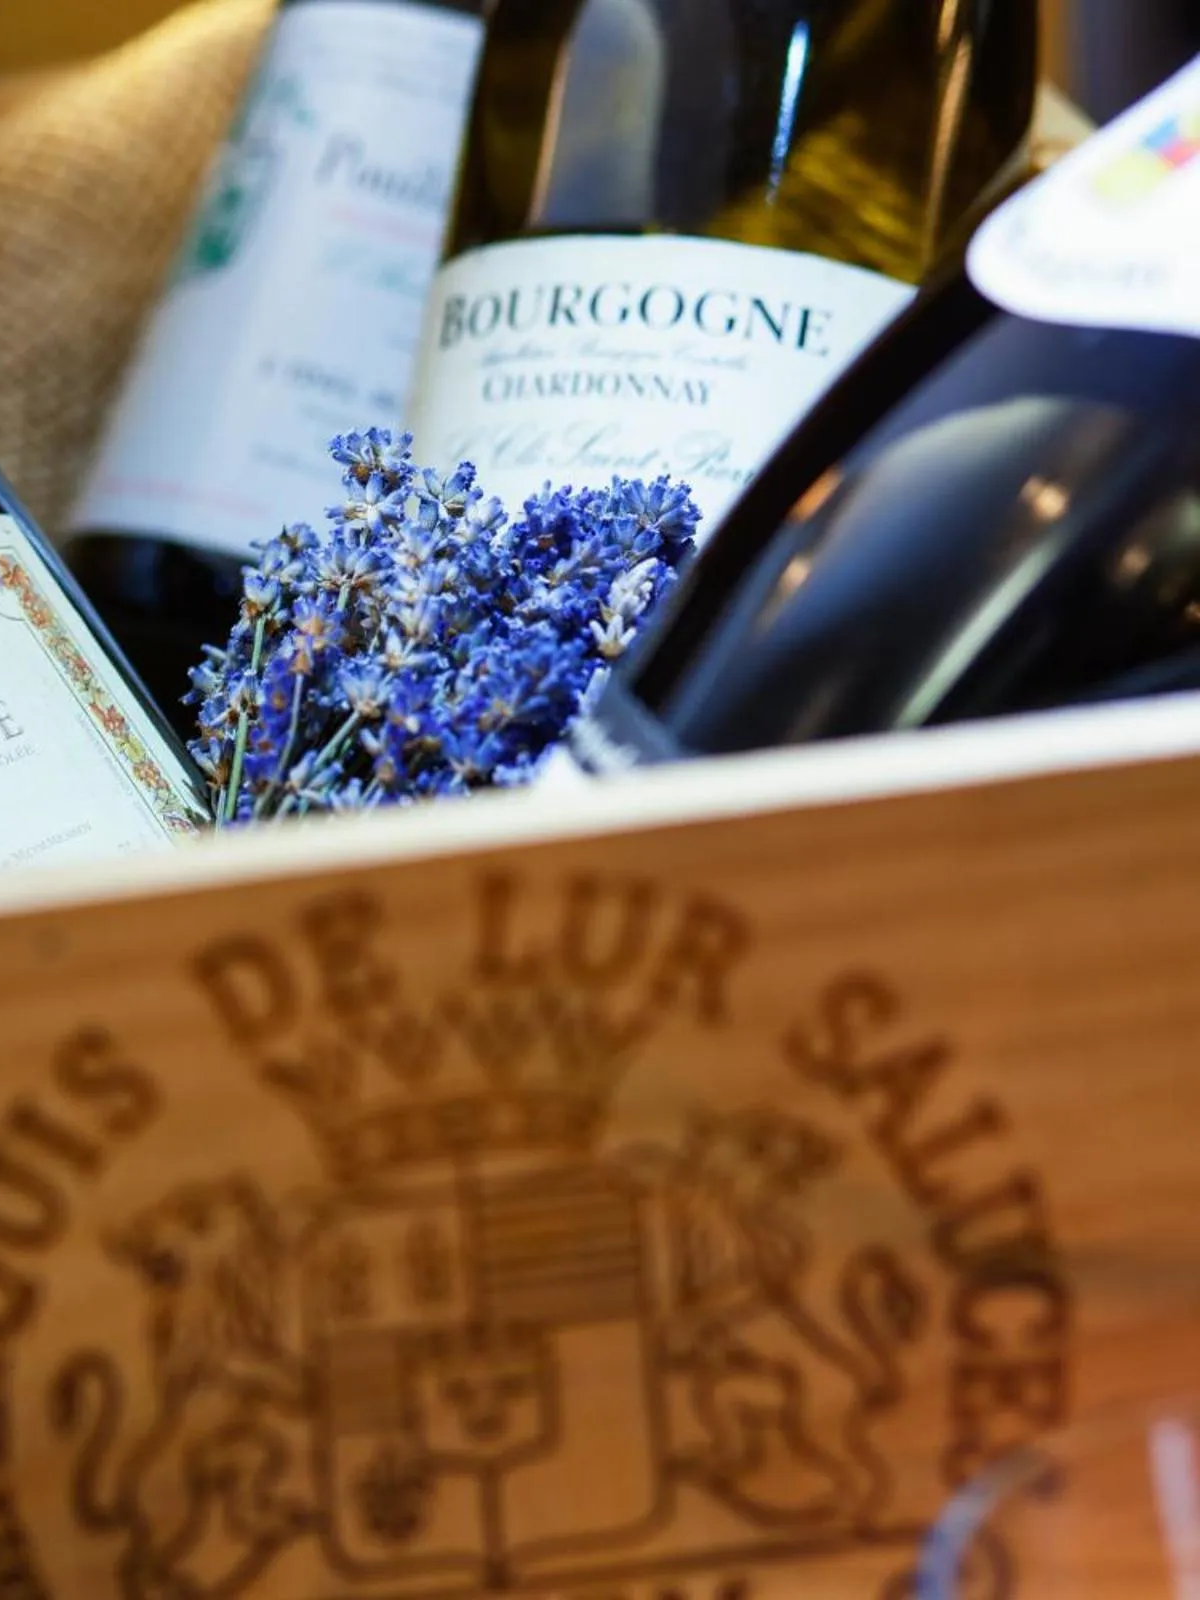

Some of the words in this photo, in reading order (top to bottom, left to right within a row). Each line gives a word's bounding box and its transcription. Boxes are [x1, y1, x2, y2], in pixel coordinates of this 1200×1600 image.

[437, 281, 834, 358] BOURGOGNE
[480, 369, 717, 407] CHARDONNAY
[184, 886, 405, 1048] DE
[471, 869, 756, 1029] LUR
